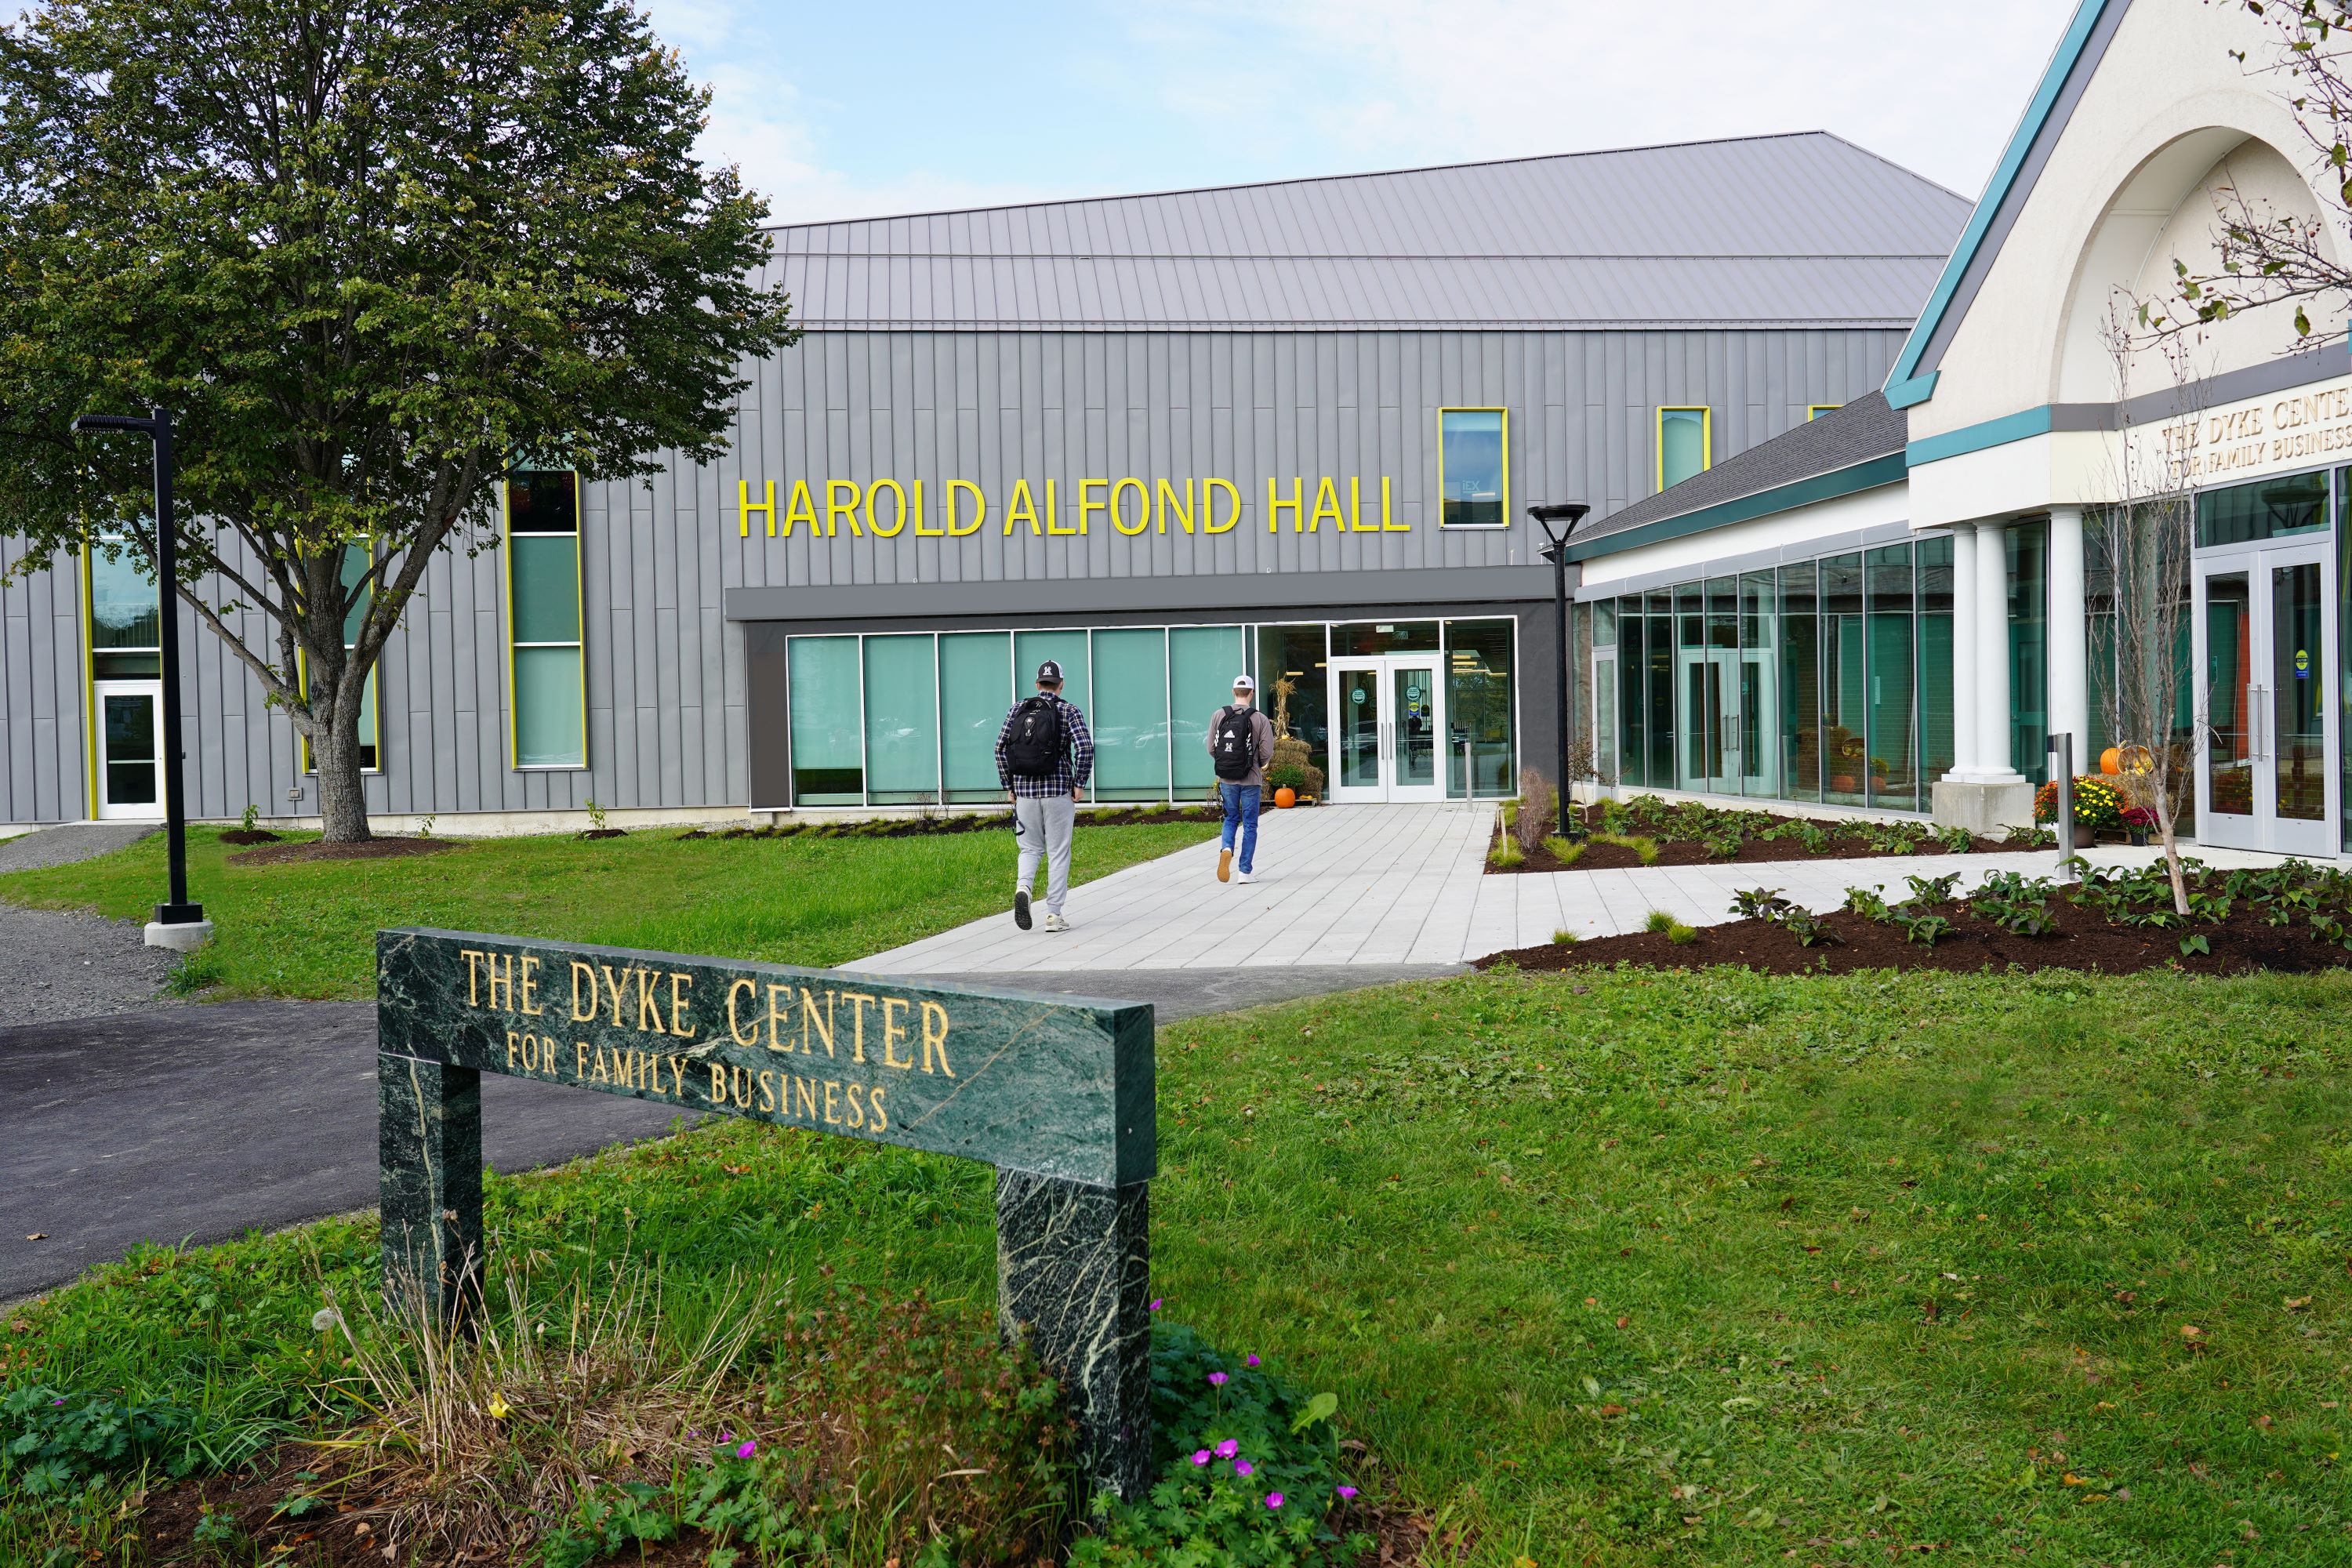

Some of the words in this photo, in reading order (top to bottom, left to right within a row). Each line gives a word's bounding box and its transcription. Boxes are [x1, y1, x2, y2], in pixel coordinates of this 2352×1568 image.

[2161, 422, 2200, 454] THE
[2209, 407, 2263, 445] DYKE
[2272, 386, 2352, 430] CENTE
[2208, 441, 2267, 473] FAMILY
[2271, 424, 2352, 461] BUSINESS
[738, 477, 985, 538] HAROLD
[1003, 477, 1242, 536] ALFOND
[1268, 475, 1411, 534] HALL
[459, 949, 543, 1016] THE
[569, 960, 696, 1039] DYKE
[727, 978, 956, 1078] CENTER
[506, 1031, 556, 1074] FOR
[575, 1041, 690, 1098] FAMILY
[710, 1062, 888, 1134] BUSINESS
